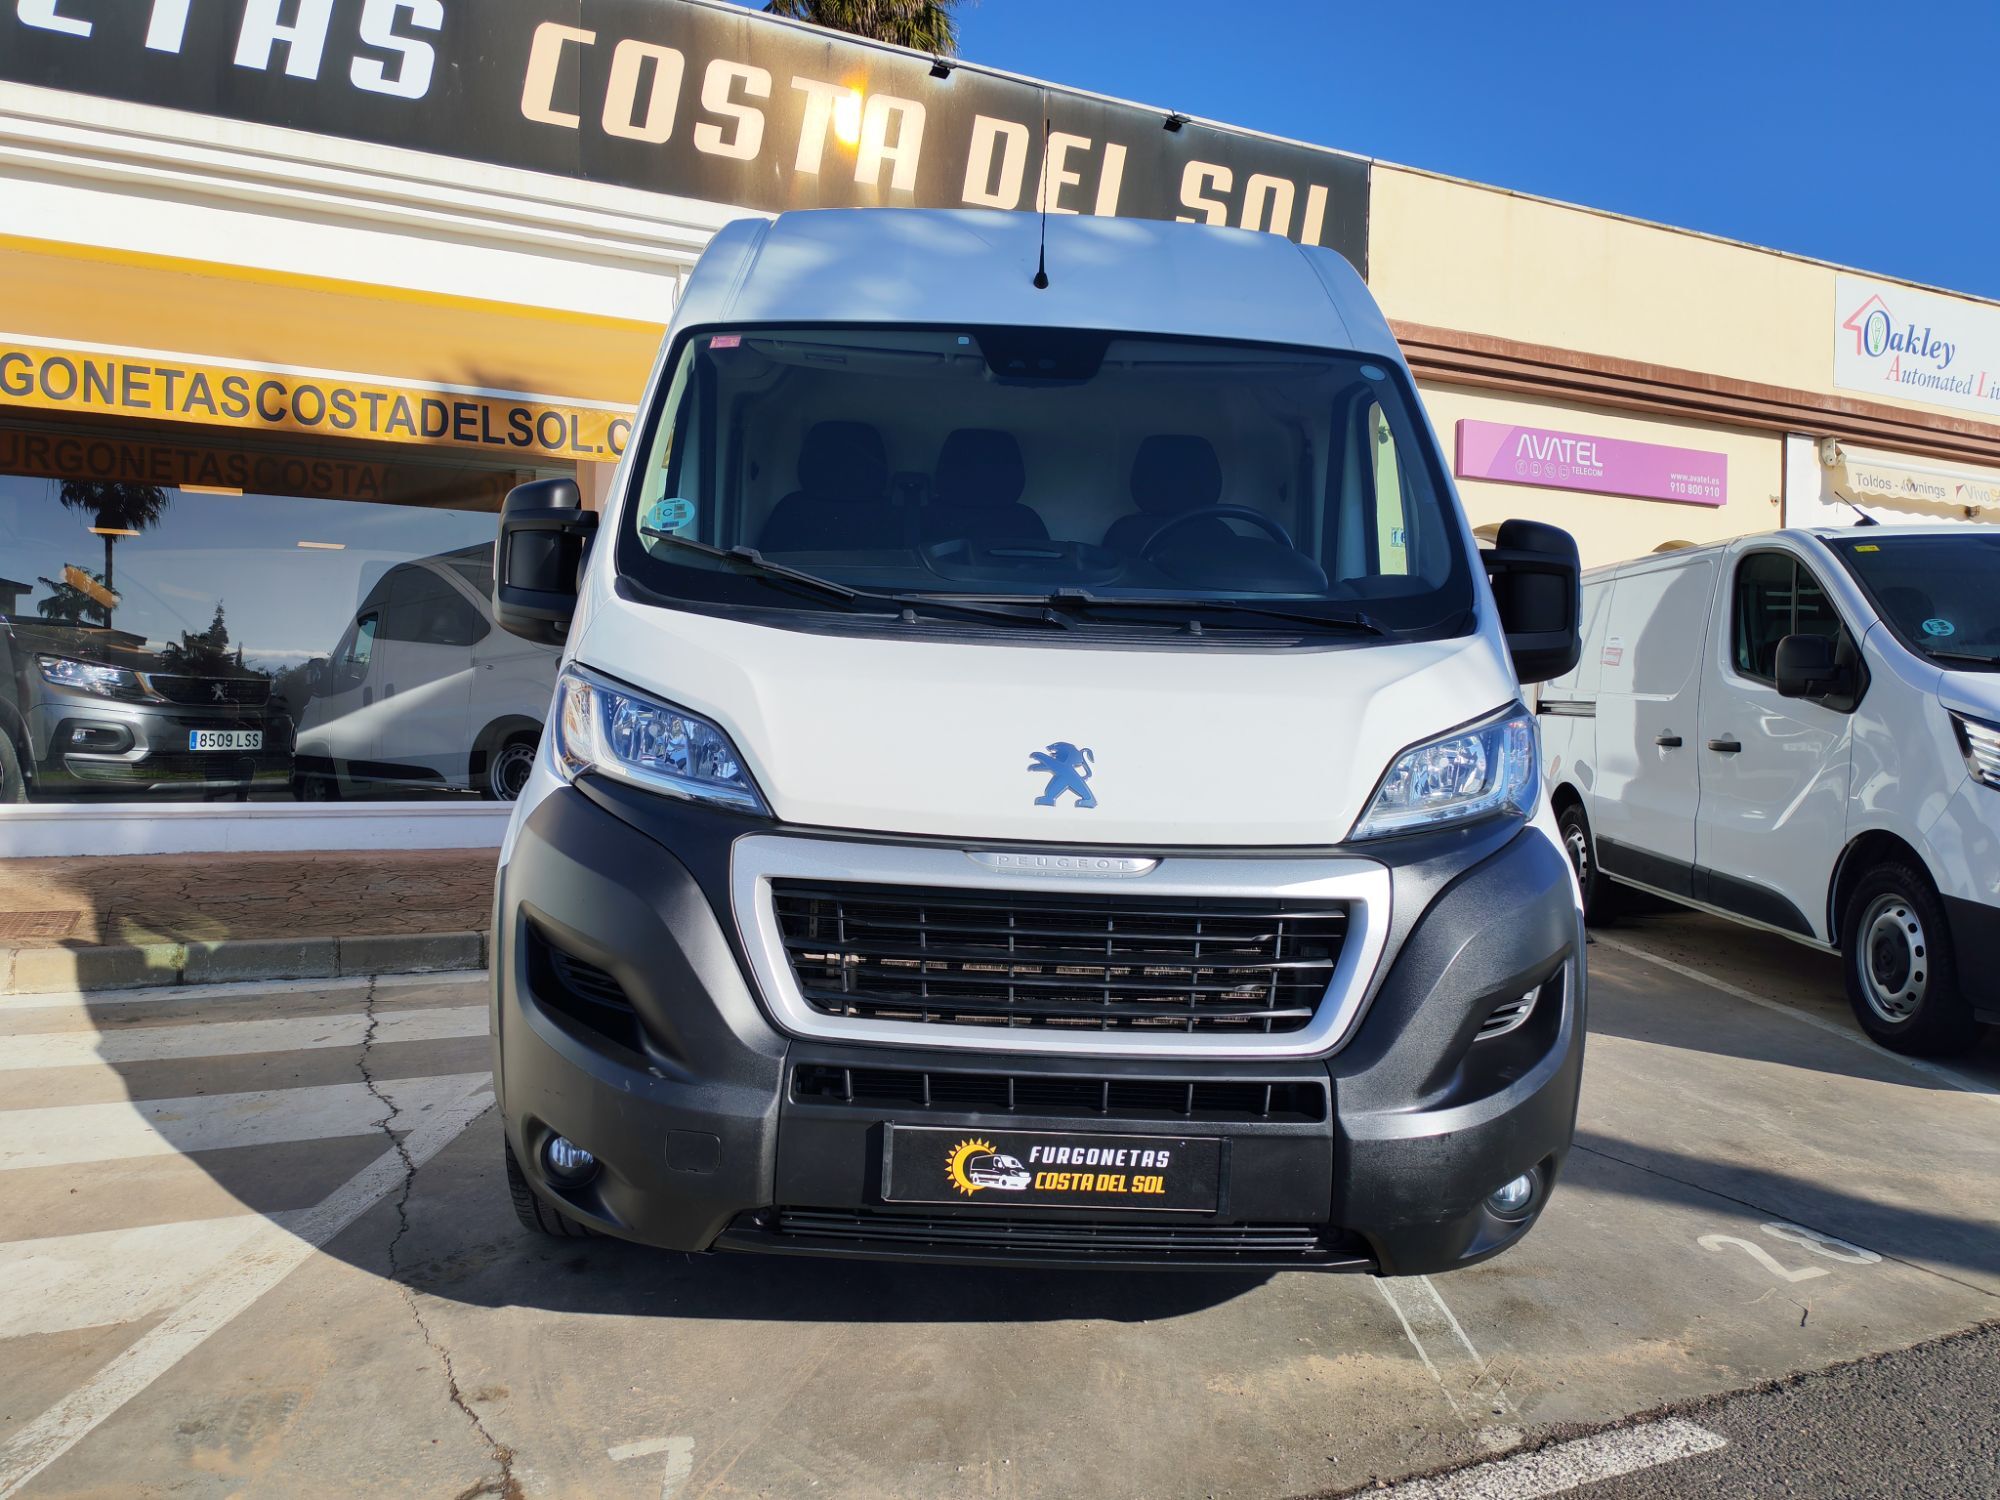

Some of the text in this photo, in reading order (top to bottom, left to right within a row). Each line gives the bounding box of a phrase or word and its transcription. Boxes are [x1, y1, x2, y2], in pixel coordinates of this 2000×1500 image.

[521, 22, 927, 192] COSTA
[1864, 310, 1955, 369] Oakley
[1885, 354, 1974, 395] Automated
[0, 352, 632, 456] GONETASCOSTADELSOL.C
[1516, 433, 1603, 467] AVATEL
[1572, 466, 1603, 477] TELECOM
[1670, 473, 1719, 485] www.avatel.es
[1856, 472, 1892, 490] Toldos
[1670, 482, 1686, 493] 910
[1704, 486, 1720, 497] 910
[200, 733, 259, 747] 8509 LSS
[996, 855, 1129, 870] PEUGEOT
[1029, 1146, 1170, 1168] FURGONETAS
[1034, 1172, 1166, 1193] COSTA DEL SOL
